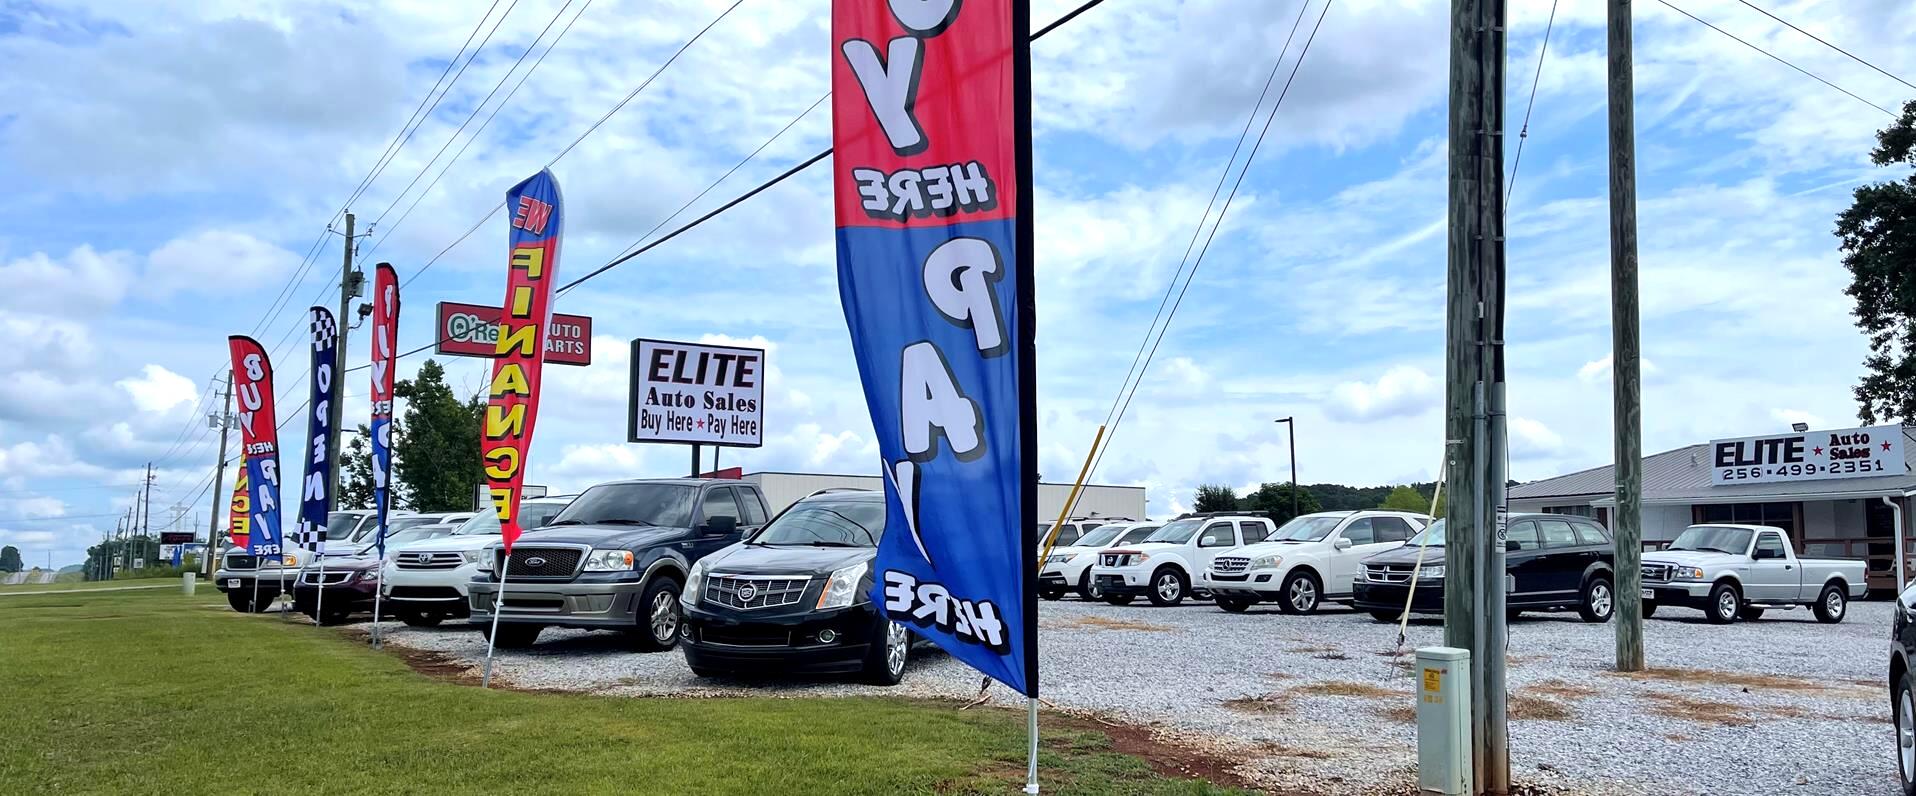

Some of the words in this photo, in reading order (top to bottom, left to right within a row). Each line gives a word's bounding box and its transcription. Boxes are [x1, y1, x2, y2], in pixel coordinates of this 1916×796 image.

[549, 324, 581, 339] UTO
[545, 339, 584, 355] ARTS
[648, 348, 758, 388] ELITE
[645, 387, 696, 408] Auto
[703, 390, 757, 413] Sales
[641, 408, 662, 435] Buy
[667, 410, 693, 431] Here
[707, 413, 726, 439] Pay
[731, 415, 757, 435] Here
[1829, 432, 1870, 447] Auto
[1715, 437, 1805, 467] ELITE
[1829, 445, 1871, 460] Sales
